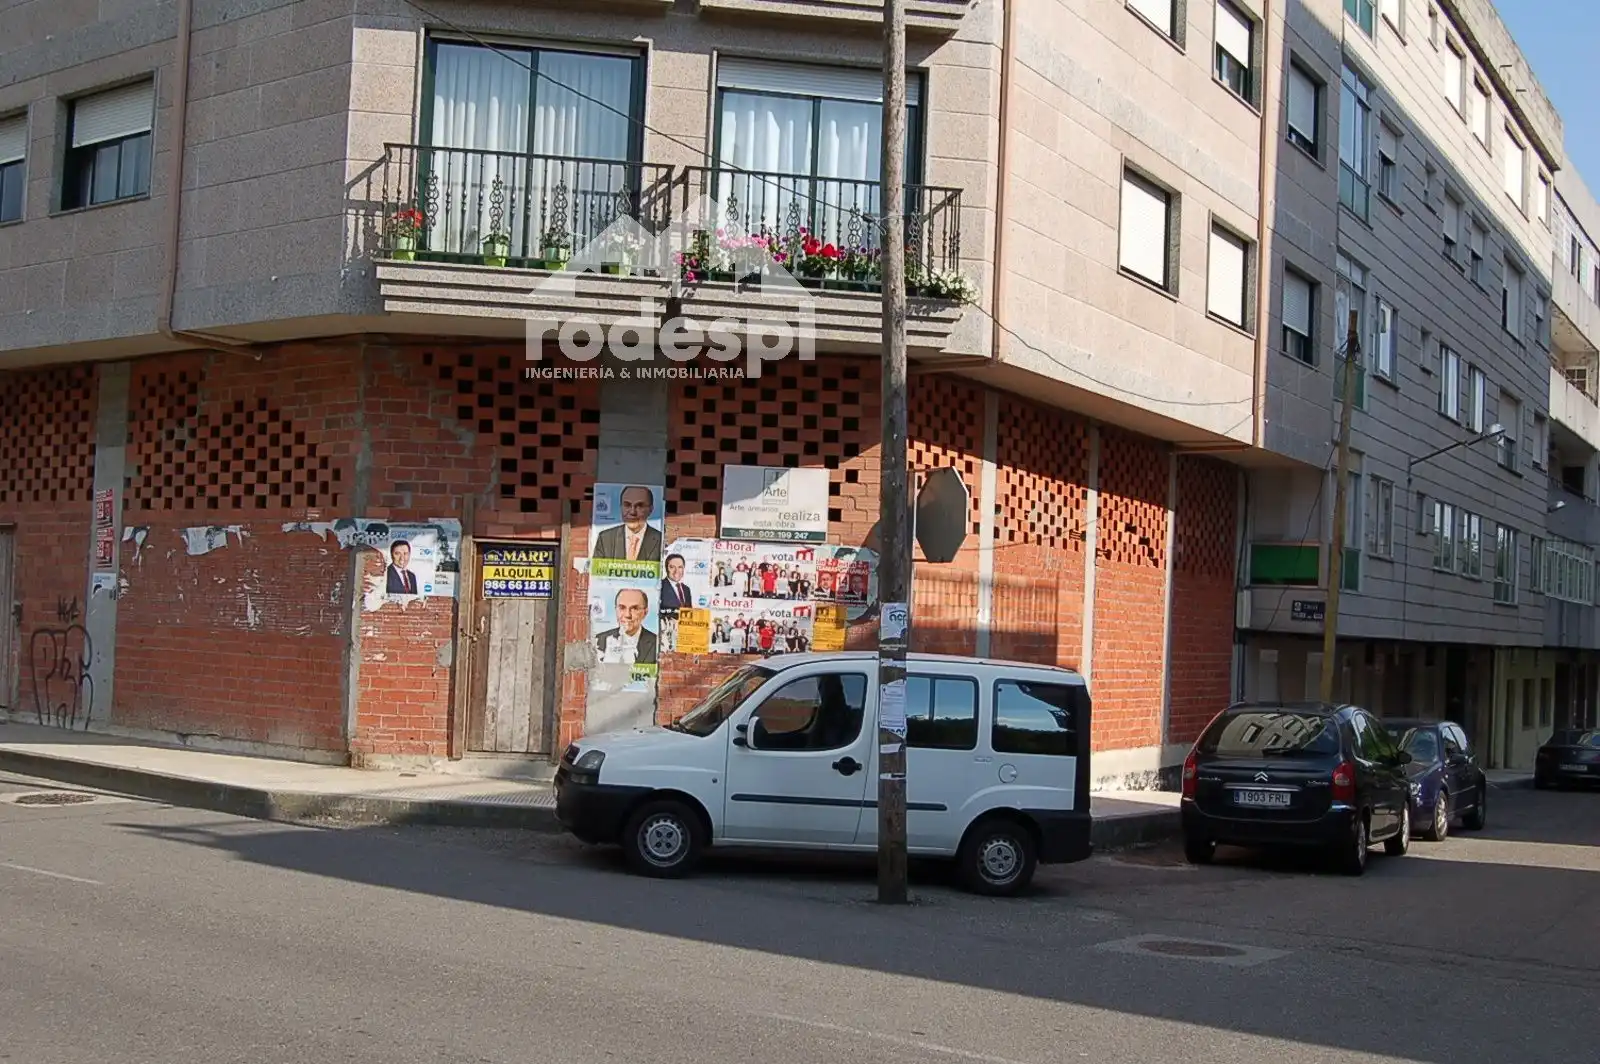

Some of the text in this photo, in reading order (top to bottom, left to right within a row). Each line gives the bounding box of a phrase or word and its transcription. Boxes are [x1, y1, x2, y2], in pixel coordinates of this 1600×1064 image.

[778, 511, 820, 522] realiza
[775, 519, 796, 529] obra
[758, 530, 775, 538] 902
[502, 550, 554, 563] MARPI
[771, 552, 794, 562] vota
[493, 567, 544, 579] ALQUILA
[608, 569, 656, 579] FUTURO
[484, 580, 506, 591] 986
[769, 609, 792, 619] vota
[1242, 792, 1288, 803] 1903 FRL
